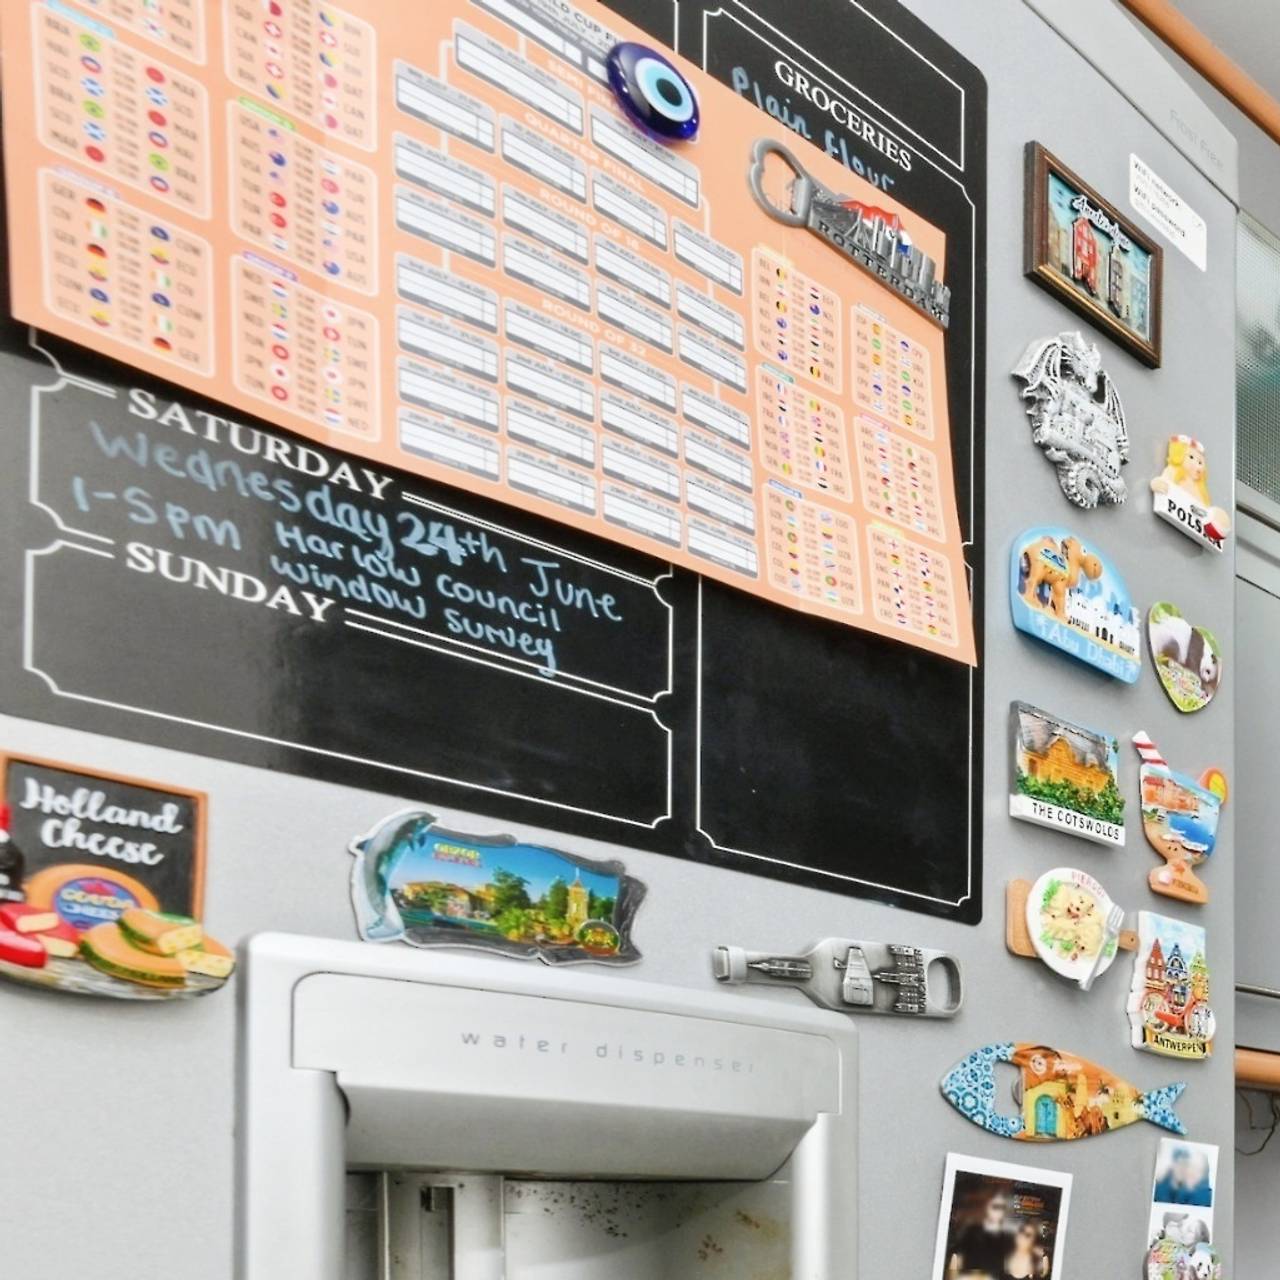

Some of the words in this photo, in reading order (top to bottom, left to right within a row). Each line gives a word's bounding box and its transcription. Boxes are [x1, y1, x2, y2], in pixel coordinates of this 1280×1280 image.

[731, 66, 812, 143] Plain
[822, 134, 896, 192] flour
[774, 59, 913, 172] GROCERIES
[816, 220, 946, 322] ROTTERDAM
[127, 388, 394, 500] SATURDAY
[89, 419, 390, 558] Wednesday
[399, 515, 507, 572] 24th
[520, 555, 624, 622] June
[274, 522, 421, 588] Harlow
[126, 542, 335, 623] SUNDAY
[19, 777, 184, 834] Holland
[40, 818, 165, 866] Cheese
[1032, 802, 1053, 823] THE
[1057, 809, 1120, 840] COTSWOLDS
[461, 1030, 569, 1055] water
[594, 1040, 757, 1076] dispenser
[1153, 1035, 1206, 1054] ANTWERPEN
